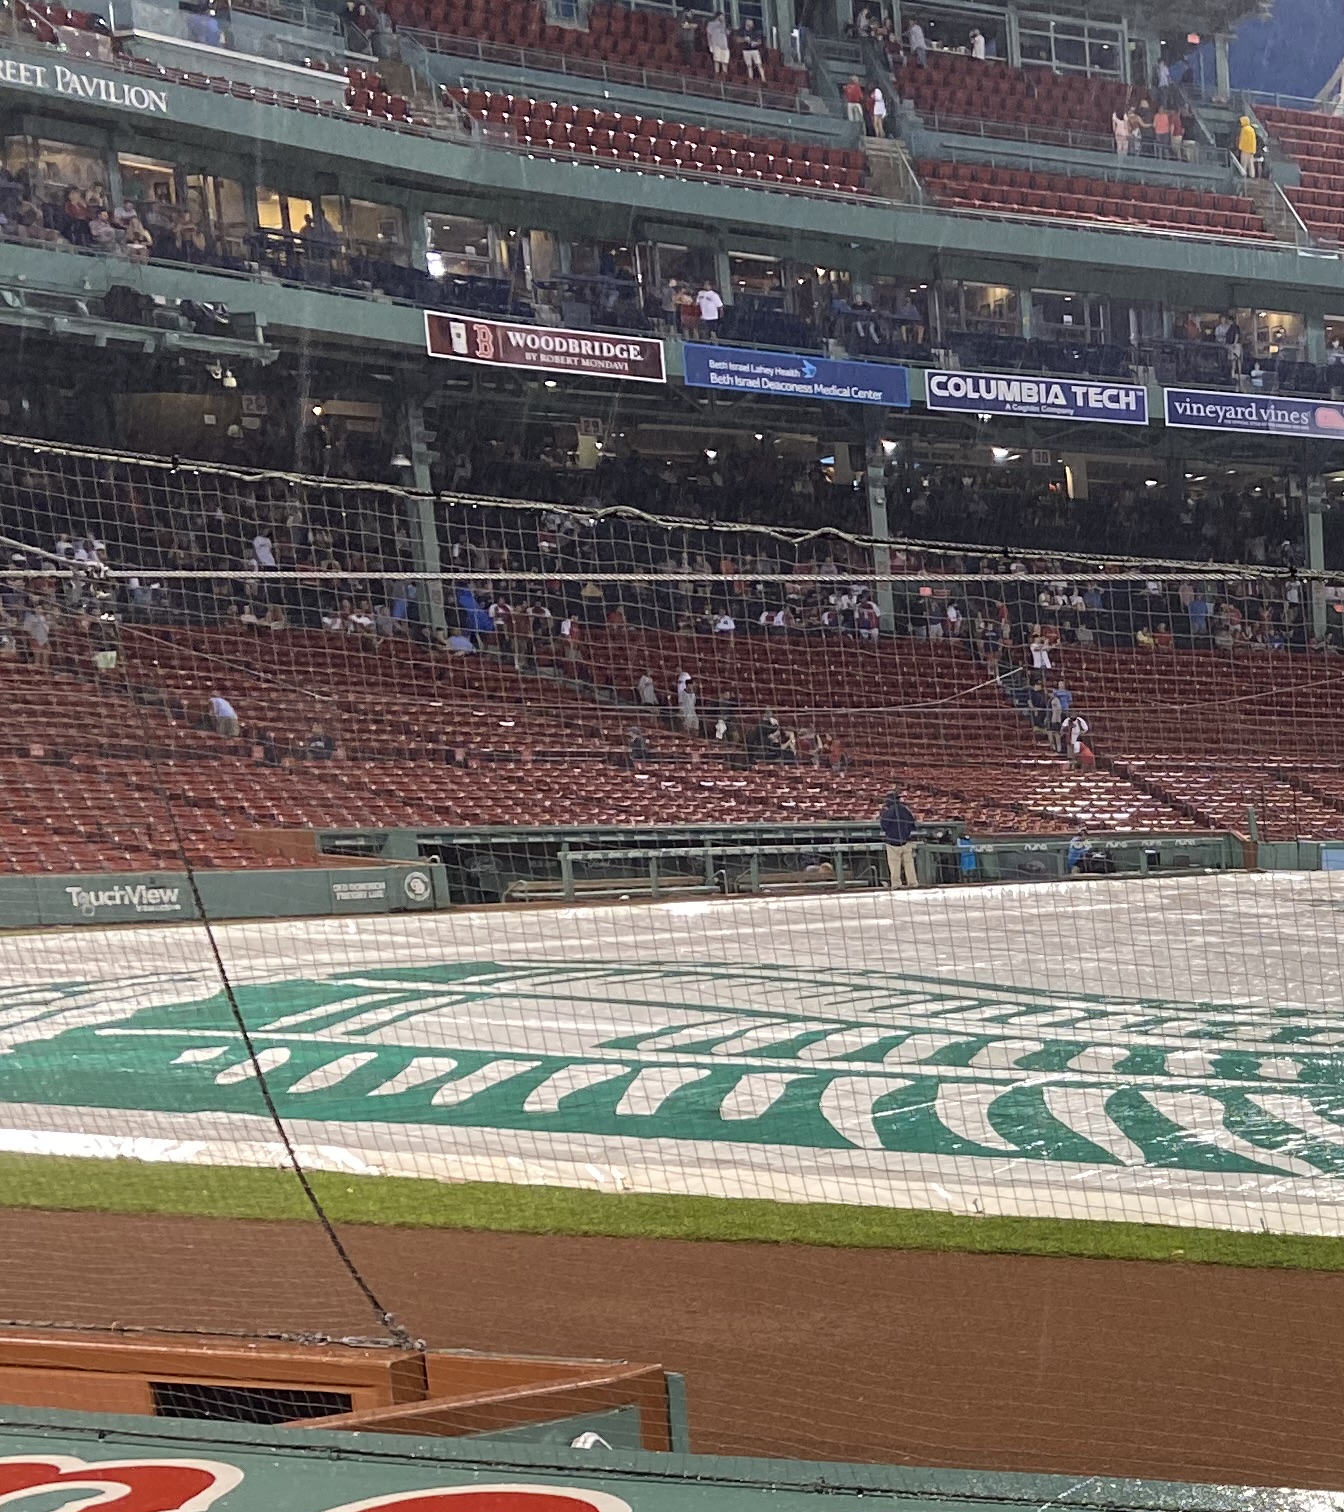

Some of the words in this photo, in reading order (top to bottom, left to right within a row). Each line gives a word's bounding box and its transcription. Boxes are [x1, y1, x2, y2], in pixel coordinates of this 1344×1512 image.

[54, 65, 167, 113] PAVILION
[506, 330, 645, 362] WOODBRIDGE
[525, 352, 538, 362] BY
[539, 353, 580, 367] ROBERT
[581, 357, 630, 371] MONDAVI
[708, 359, 727, 370] Beth
[728, 361, 749, 372] Israel
[750, 363, 774, 377] Lahey
[774, 366, 801, 377] Health
[709, 372, 734, 386] Beth
[735, 375, 760, 388] Israel
[762, 378, 813, 394] Deaconess
[814, 383, 850, 398] Medical
[851, 387, 883, 400] Center
[930, 375, 1067, 405] COLUMBIA
[1071, 386, 1136, 411] TECH
[1174, 398, 1257, 424] vineyard
[1259, 405, 1310, 424] vines
[65, 884, 179, 907] TouchView
